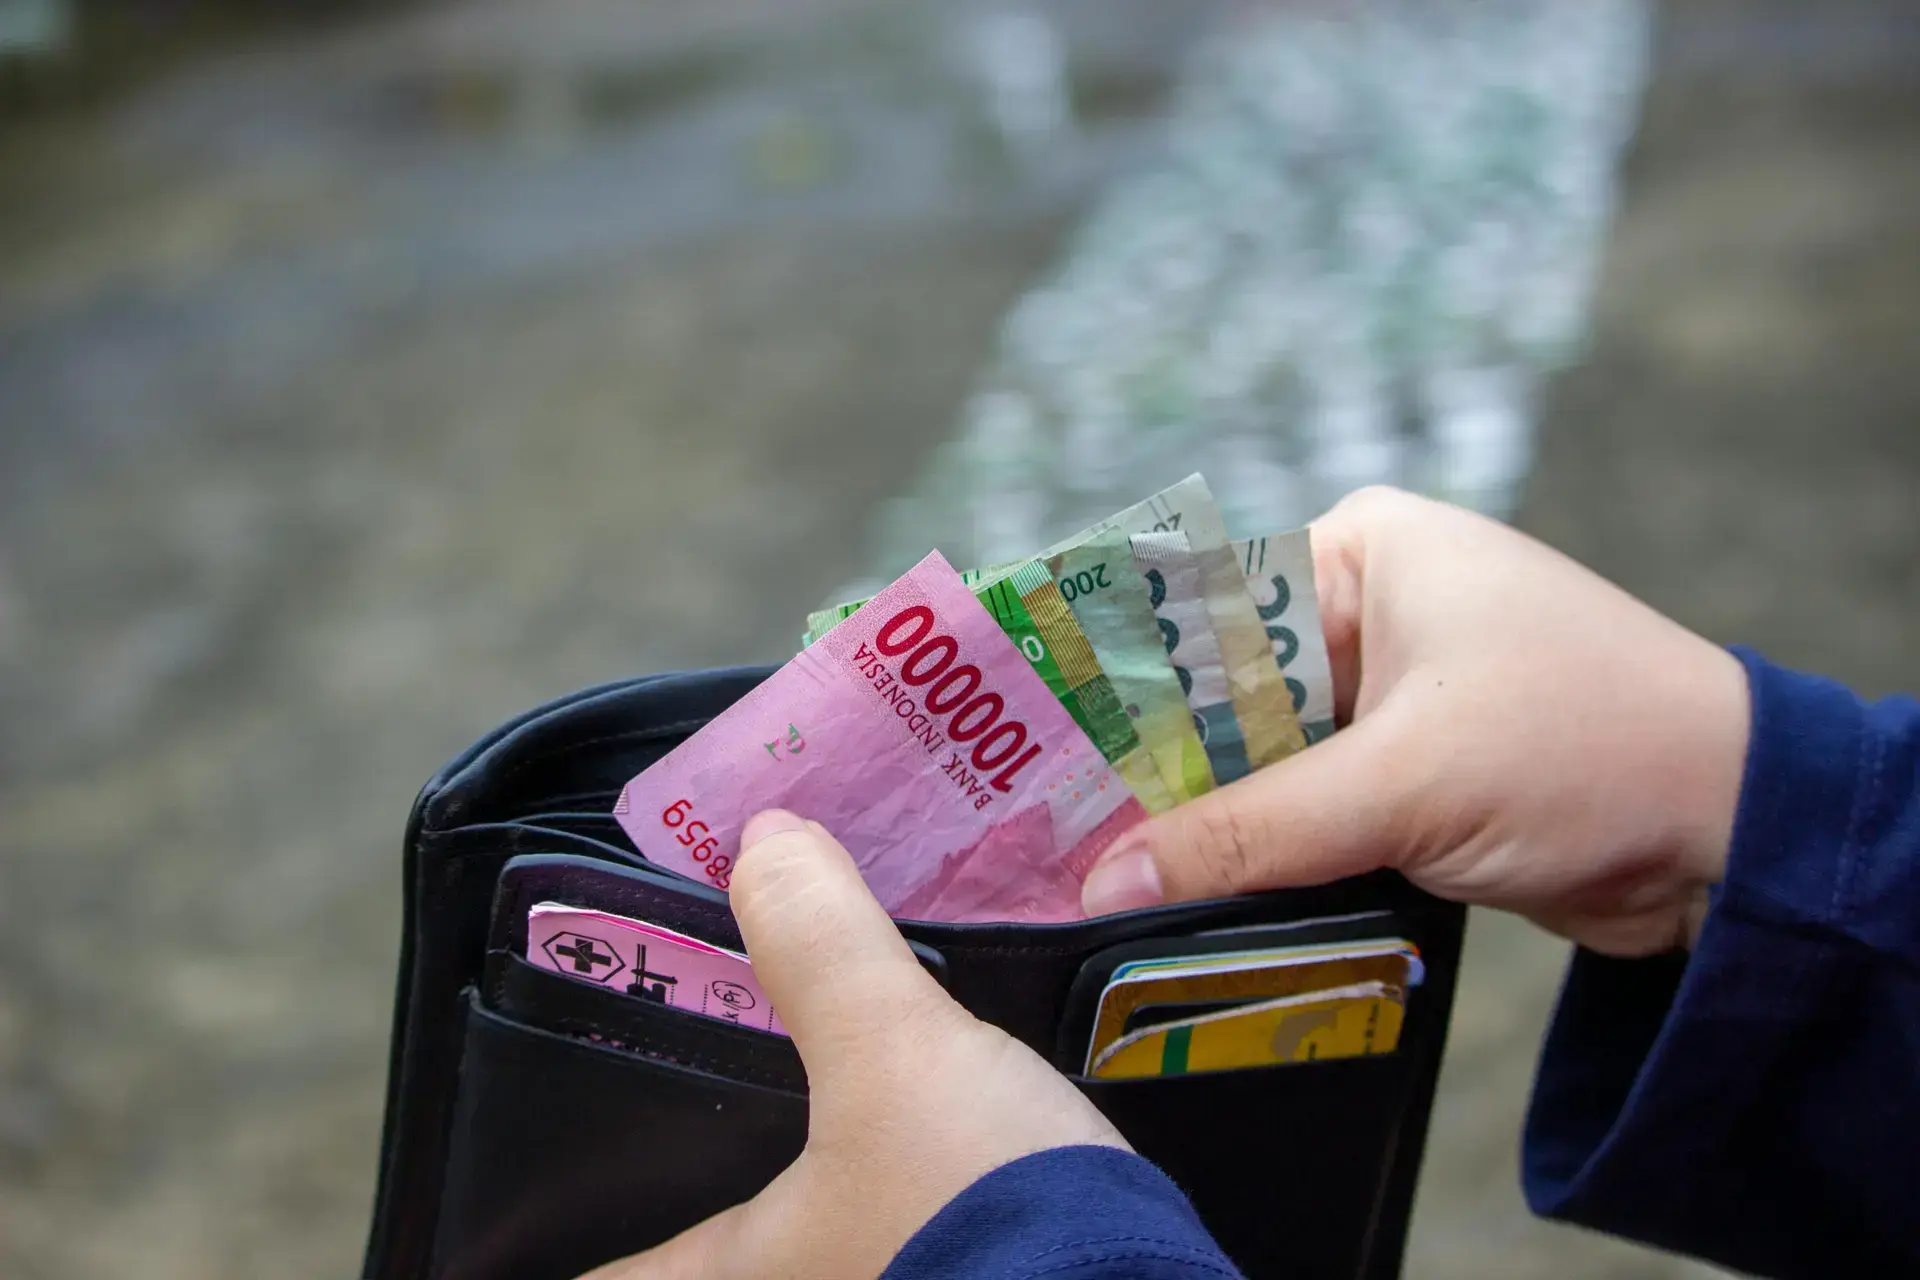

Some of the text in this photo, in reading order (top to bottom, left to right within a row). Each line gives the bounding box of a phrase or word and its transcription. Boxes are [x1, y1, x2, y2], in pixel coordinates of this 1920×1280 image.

[854, 642, 993, 811] BANK INDONESIA
[876, 605, 1042, 793] 100000
